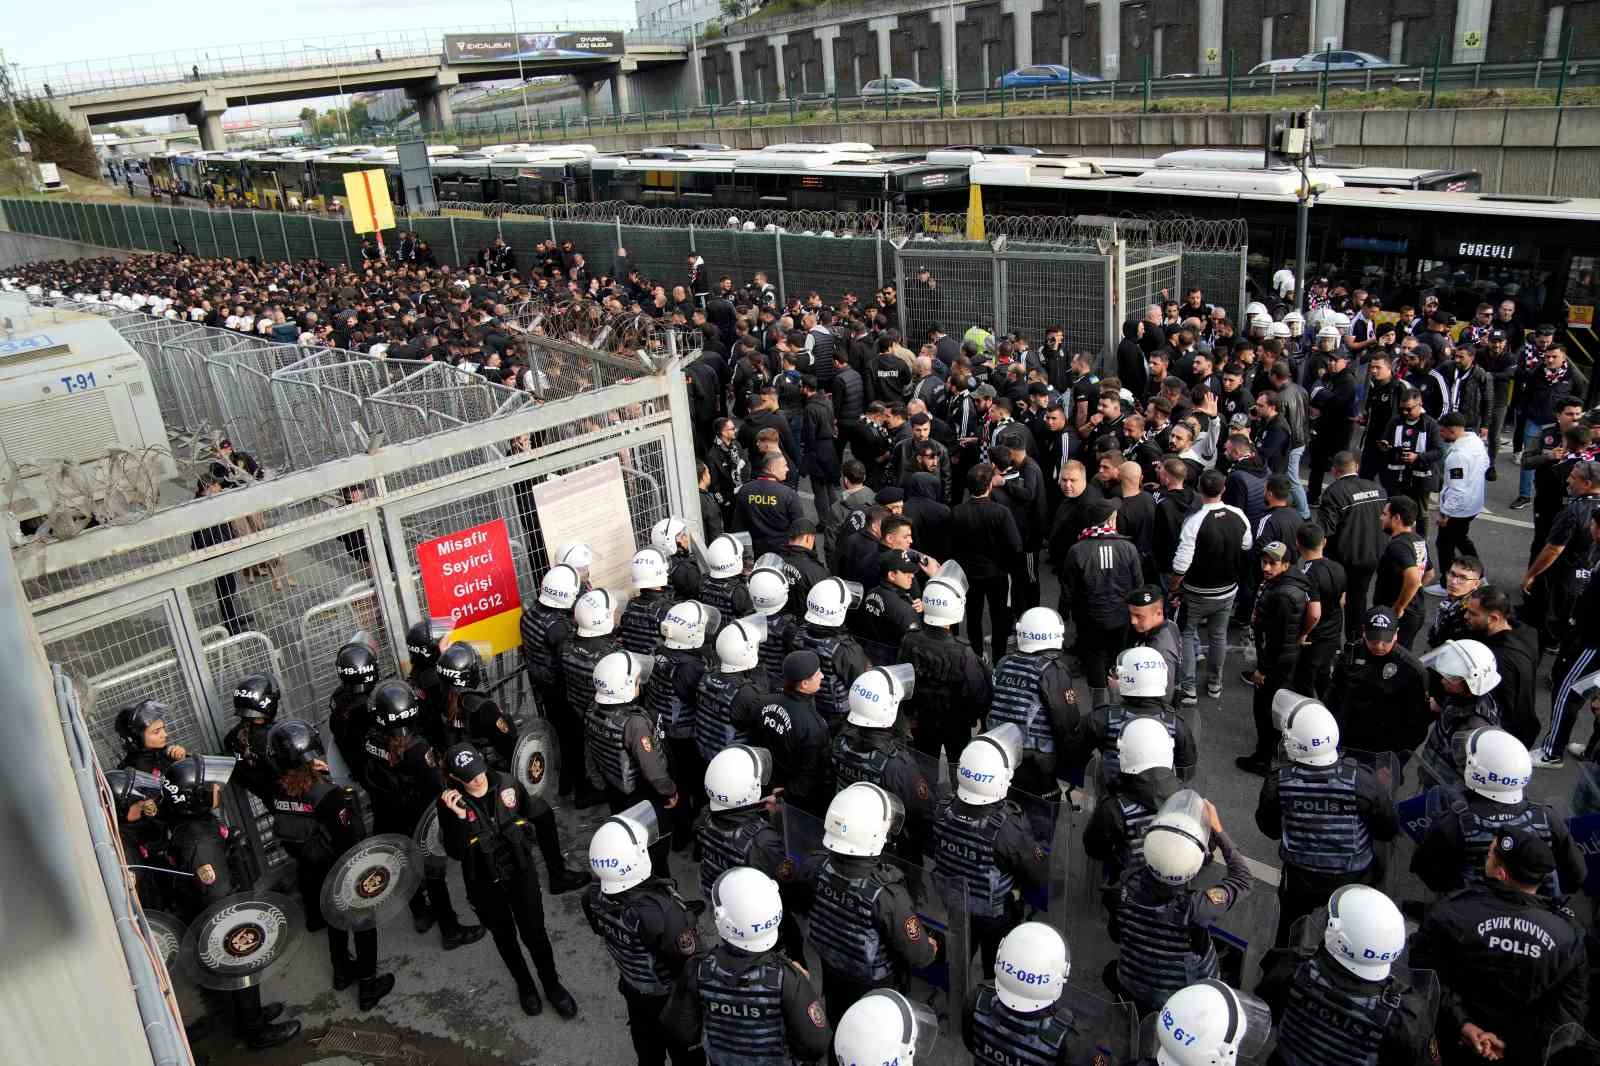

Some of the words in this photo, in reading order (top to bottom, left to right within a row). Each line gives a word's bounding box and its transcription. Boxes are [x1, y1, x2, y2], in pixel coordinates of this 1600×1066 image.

[60, 371, 97, 393] T-91
[437, 531, 488, 556] Misafir
[442, 549, 494, 576] Seyirci
[453, 575, 493, 598] Girişi
[451, 593, 503, 621] G11-G12
[1477, 916, 1512, 937] ÇEVİK
[1513, 918, 1557, 951] KUVVET
[709, 1001, 761, 1018] POLİS
